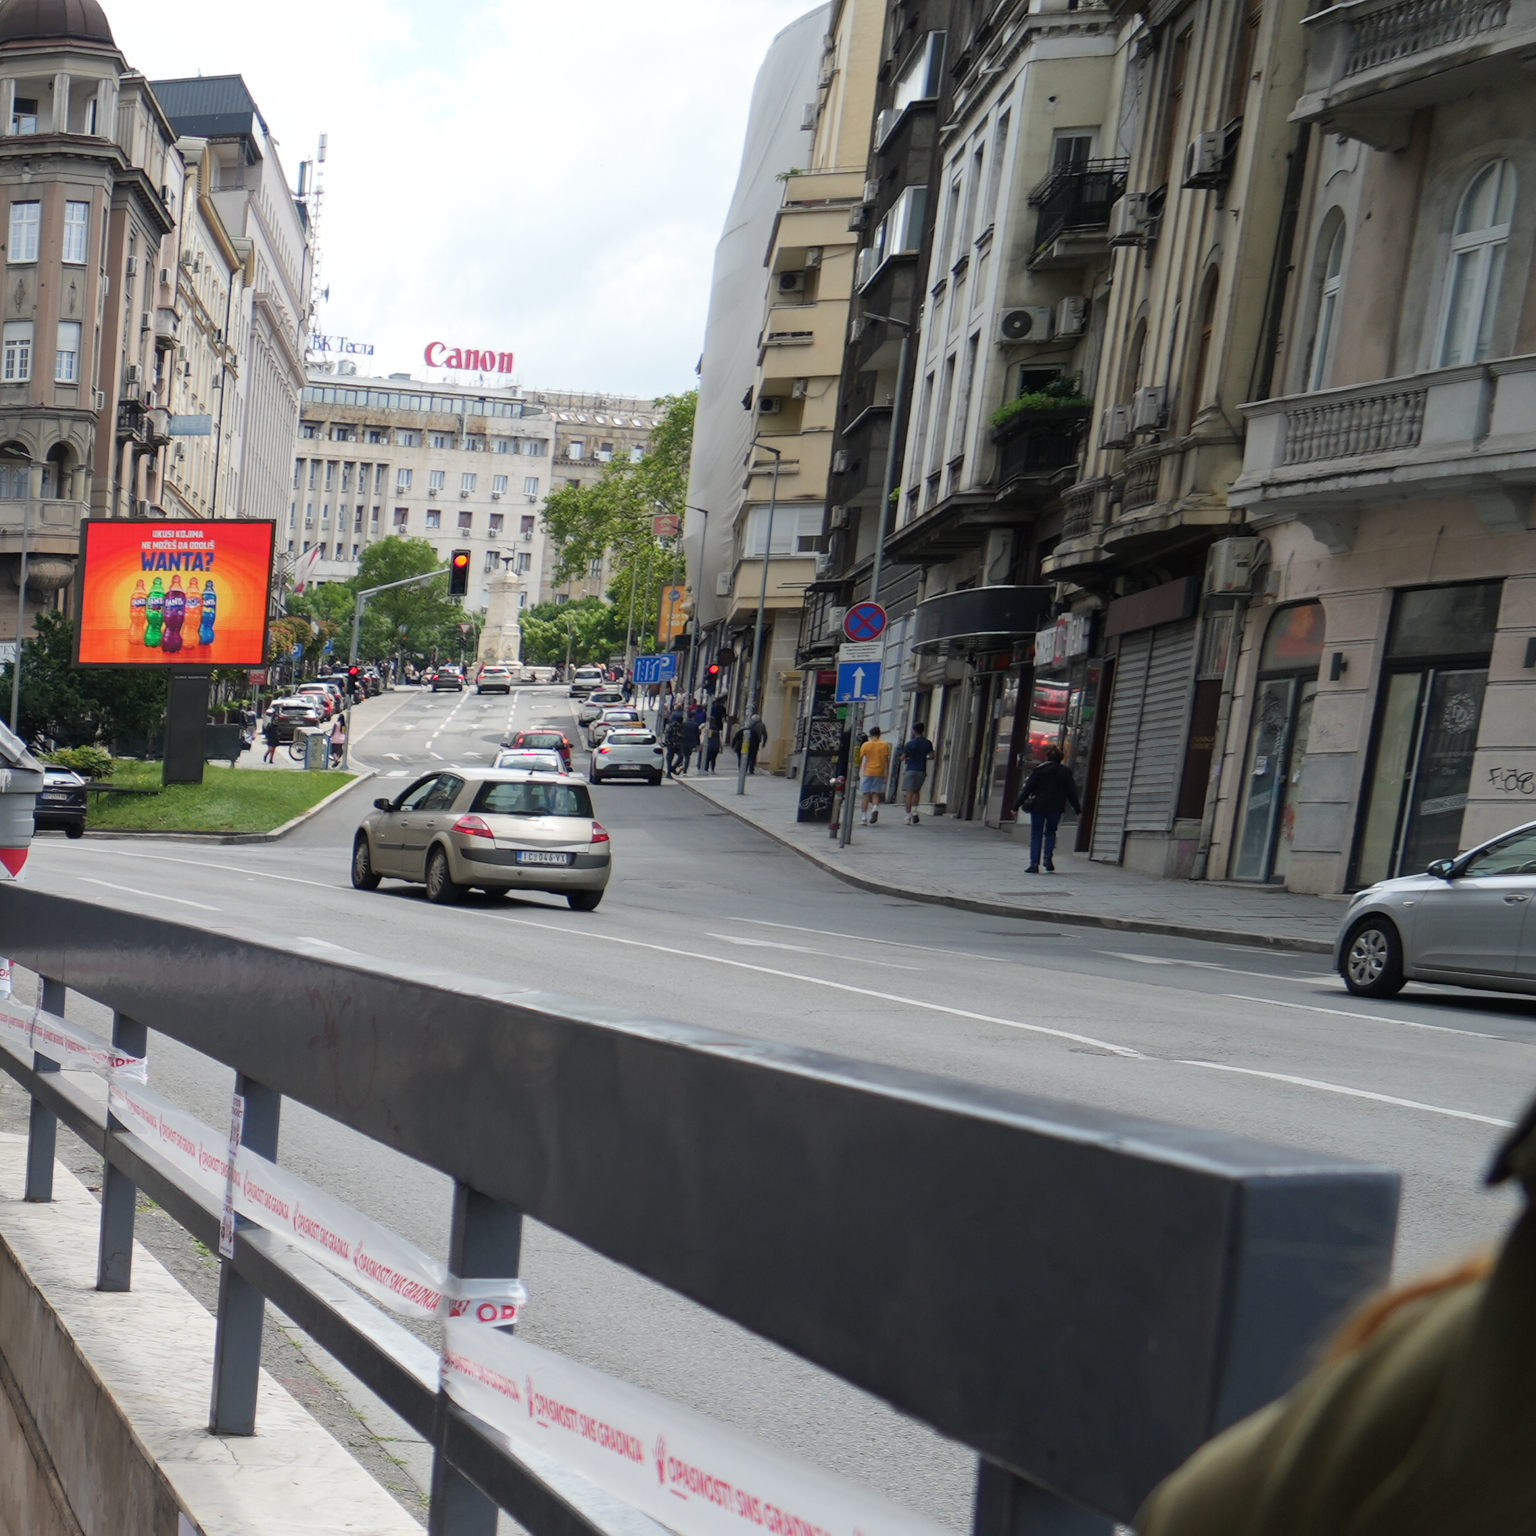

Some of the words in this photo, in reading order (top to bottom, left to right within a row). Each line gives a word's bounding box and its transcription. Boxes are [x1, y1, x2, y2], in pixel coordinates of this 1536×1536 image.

[336, 336, 374, 355] Тесла
[424, 341, 514, 373] Canon
[152, 530, 175, 538] UKUSI
[141, 541, 151, 549] NE
[153, 540, 177, 549] MOŽEŠ
[141, 552, 215, 572] WANTA?
[534, 1391, 579, 1433] OPASNOST!
[580, 1412, 597, 1442] SNS
[597, 1420, 645, 1467] GRADNJA
[668, 1455, 734, 1514] OPASNOST!
[736, 1487, 762, 1528] SNS
